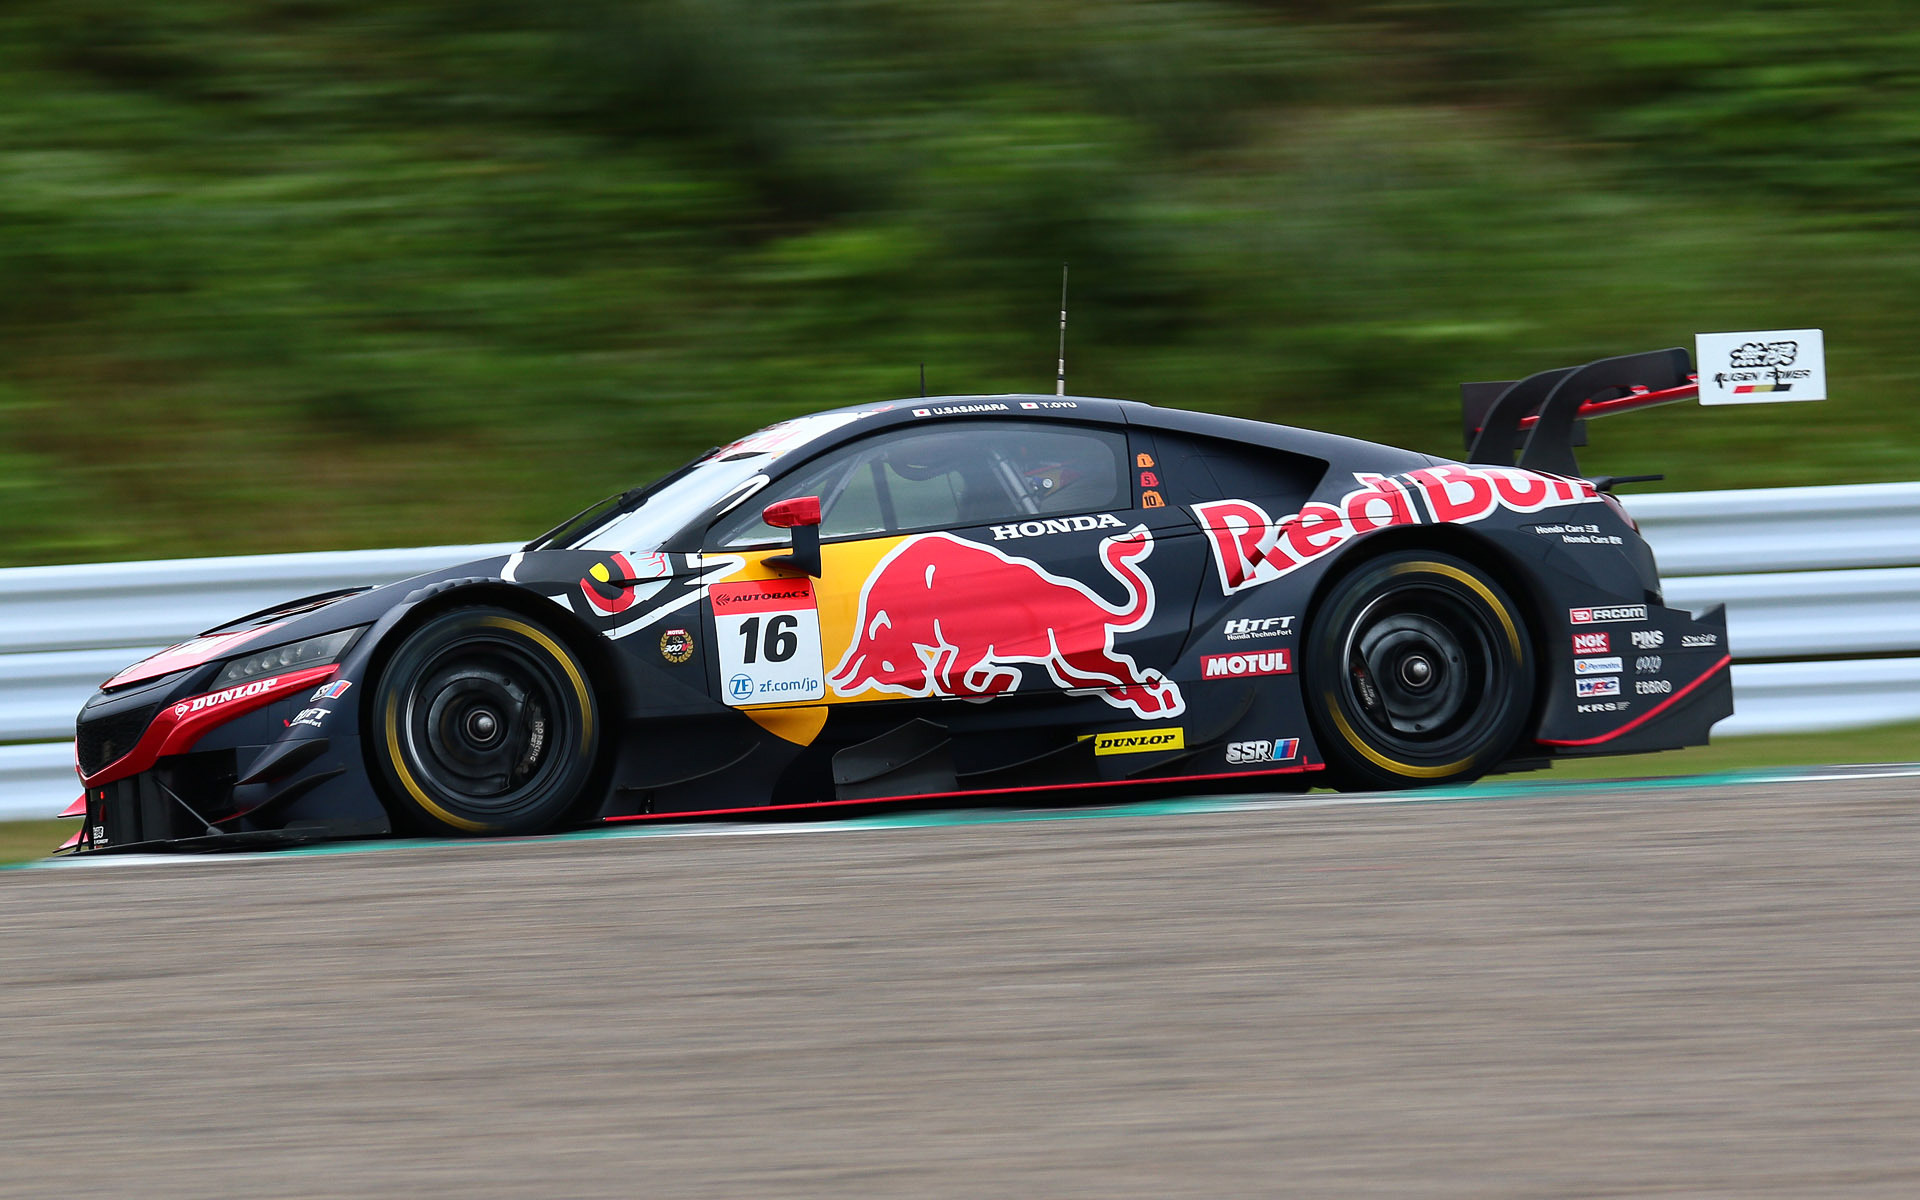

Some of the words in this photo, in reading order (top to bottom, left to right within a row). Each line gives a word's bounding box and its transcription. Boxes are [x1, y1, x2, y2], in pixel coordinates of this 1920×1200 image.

[932, 403, 1009, 415] U.SASAHARA
[1144, 495, 1157, 506] 10
[989, 513, 1127, 541] HONDA
[1192, 472, 1420, 594] Red
[1534, 525, 1565, 534] Honda
[1562, 534, 1591, 544] Honda
[732, 590, 809, 602] AUTOBACS
[1592, 607, 1644, 620] FACOM
[1224, 616, 1295, 634] HTFT
[739, 615, 797, 664] 16
[1574, 633, 1607, 649] NGK
[1631, 630, 1664, 645] PINS
[664, 643, 690, 652] 300V
[1206, 652, 1288, 677] MOTUL
[730, 678, 753, 695] ZF
[759, 677, 818, 693] zf.com/jp
[190, 678, 278, 712] DUNLOP
[1577, 702, 1616, 713] KRS
[1099, 734, 1175, 749] DUNLOP
[1226, 739, 1273, 765] SSR
